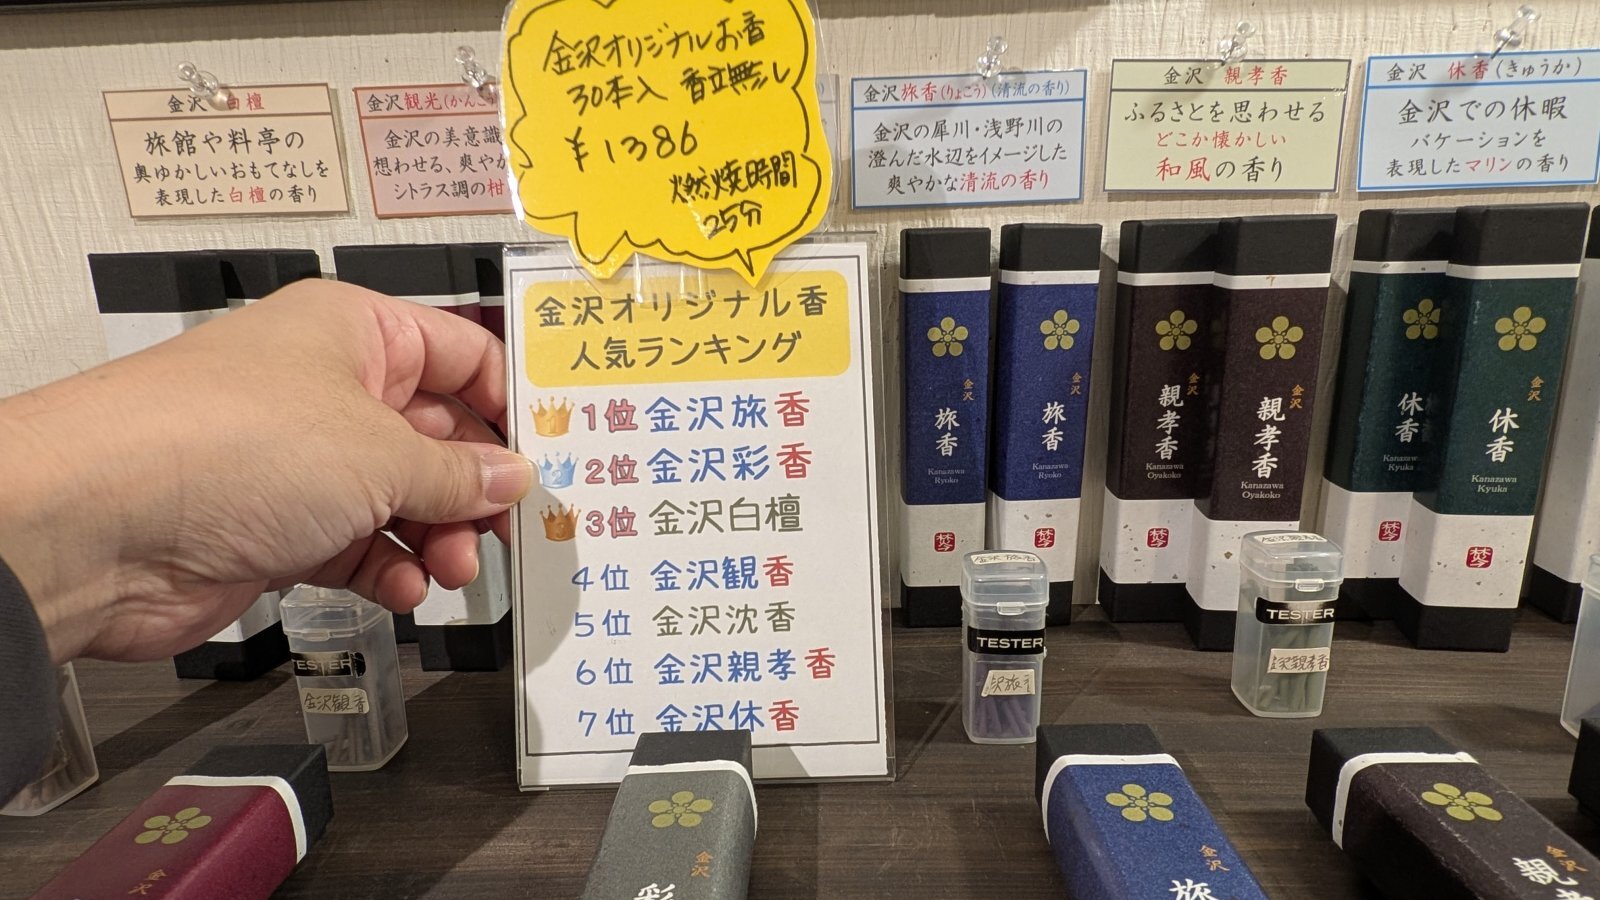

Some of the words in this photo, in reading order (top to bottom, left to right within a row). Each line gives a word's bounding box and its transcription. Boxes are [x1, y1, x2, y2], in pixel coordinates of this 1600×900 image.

[543, 10, 765, 76] 金沢オリジナルお香
[1164, 65, 1204, 85] 金沢
[1224, 65, 1288, 86] 親孝香
[1386, 63, 1427, 82] 金沢
[567, 75, 668, 116] 30本入
[680, 60, 791, 105] 香立無し
[167, 94, 208, 113] 金沢
[227, 92, 264, 111] 白檀
[1125, 100, 1325, 123] ふるさとを思わせる
[1398, 95, 1568, 125] 金沢での休暇
[145, 126, 304, 156] 旅館や料亭の
[384, 126, 503, 150] 金沢の美意識
[873, 116, 1063, 142] 金沢の犀川・浅野川の
[1157, 130, 1287, 150] どこか懐かしい
[1411, 128, 1547, 151] バケーションを
[868, 143, 1068, 169] 澄んだ水辺をイメージした
[1156, 155, 1283, 183] 和風の香り
[1386, 153, 1569, 178] 表現したマリンの香り
[134, 157, 329, 182] 奥ゆかしいおもてなしを
[669, 150, 798, 204] 燃焼時間
[887, 169, 1050, 196] 爽やかな清流の香り
[154, 182, 318, 206] 表現した白檀の香り
[394, 178, 504, 200] シトラス調の柑
[703, 200, 763, 240] 25分
[534, 285, 829, 328] 金沢オリジナル香
[571, 330, 803, 371] 人気ランキング
[962, 378, 974, 401] 金沢
[1070, 372, 1082, 395] 金沢
[1289, 384, 1304, 409] 金沢
[1527, 375, 1544, 401] 金沢
[581, 398, 639, 433] 1位
[644, 390, 811, 434] 金沢旅香
[1155, 384, 1184, 461] 親孝香
[1395, 392, 1424, 443] 休香
[934, 407, 960, 457] 旅香
[1041, 401, 1067, 451] 旅香
[1252, 396, 1285, 479] 親孝香
[1485, 407, 1520, 463] 休香
[585, 454, 639, 487] 2位
[647, 442, 813, 485] 金沢彩香
[1032, 462, 1069, 471] Kanazawa
[1145, 462, 1184, 471] Kanazawa
[1383, 454, 1418, 462] Kanazaw
[1147, 472, 1182, 480] Oyakoko
[1241, 481, 1284, 490] Kanazawa
[1471, 474, 1517, 484] Kanazawa
[1477, 484, 1508, 493] Kyuka
[1242, 491, 1281, 500] Oyakoko
[585, 505, 639, 539] 3位
[649, 493, 804, 536] 金沢白檀
[571, 563, 630, 592] 4位
[650, 555, 795, 592] 金沢観香
[574, 609, 632, 638] 5位
[652, 600, 796, 638] 金沢沈香
[1267, 608, 1334, 620] TESTER
[977, 636, 1044, 649] TESTER
[576, 657, 634, 686] 6位
[653, 647, 836, 685] 金沢親孝香
[578, 707, 636, 737] 7位
[655, 699, 800, 733] 金沢休香
[691, 851, 714, 878] 金沢
[1200, 844, 1230, 871] 金沢
